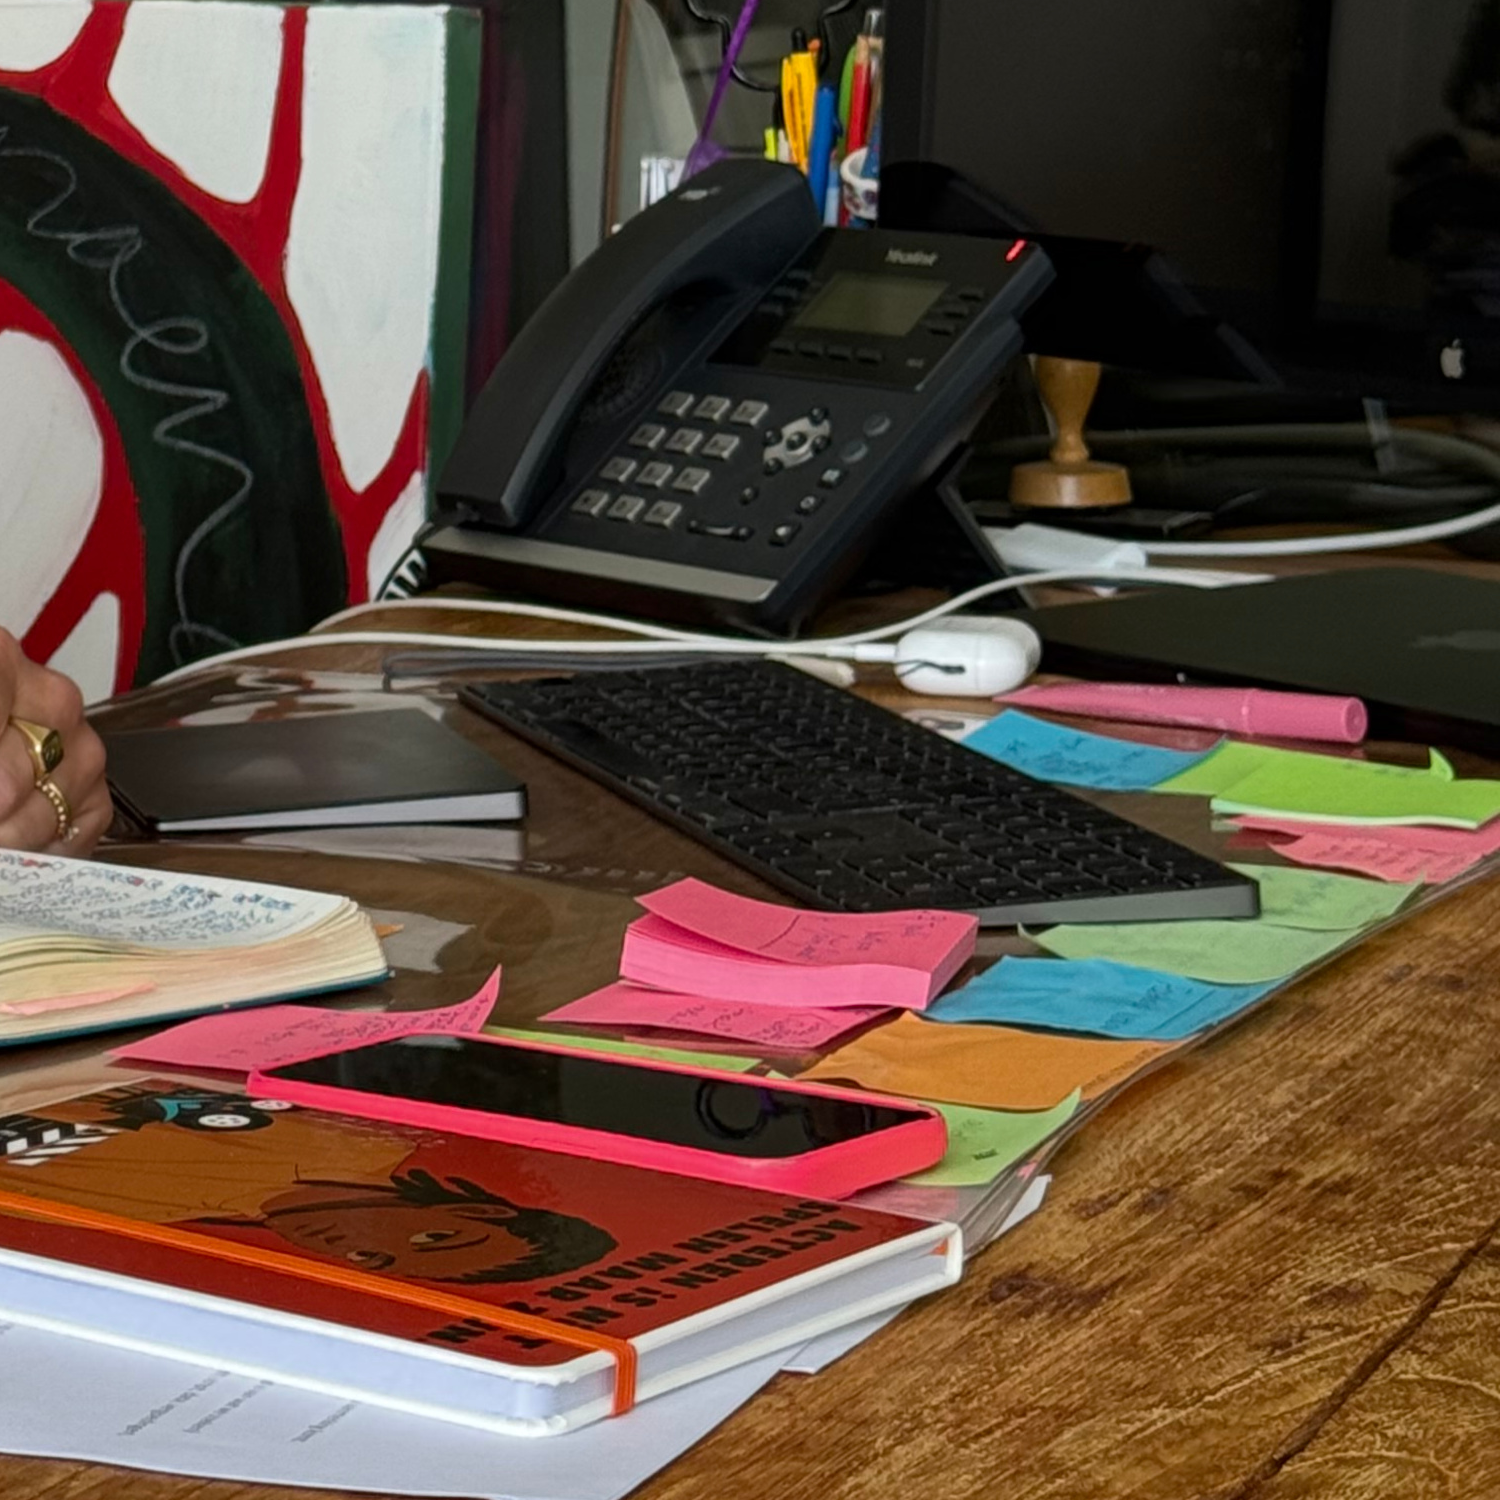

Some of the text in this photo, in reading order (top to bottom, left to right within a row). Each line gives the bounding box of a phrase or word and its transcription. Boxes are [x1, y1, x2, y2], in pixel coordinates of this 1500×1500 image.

[659, 1219, 863, 1289] ACTEREN
[672, 1201, 842, 1254] SPELEN
[535, 1252, 689, 1302] MAAR
